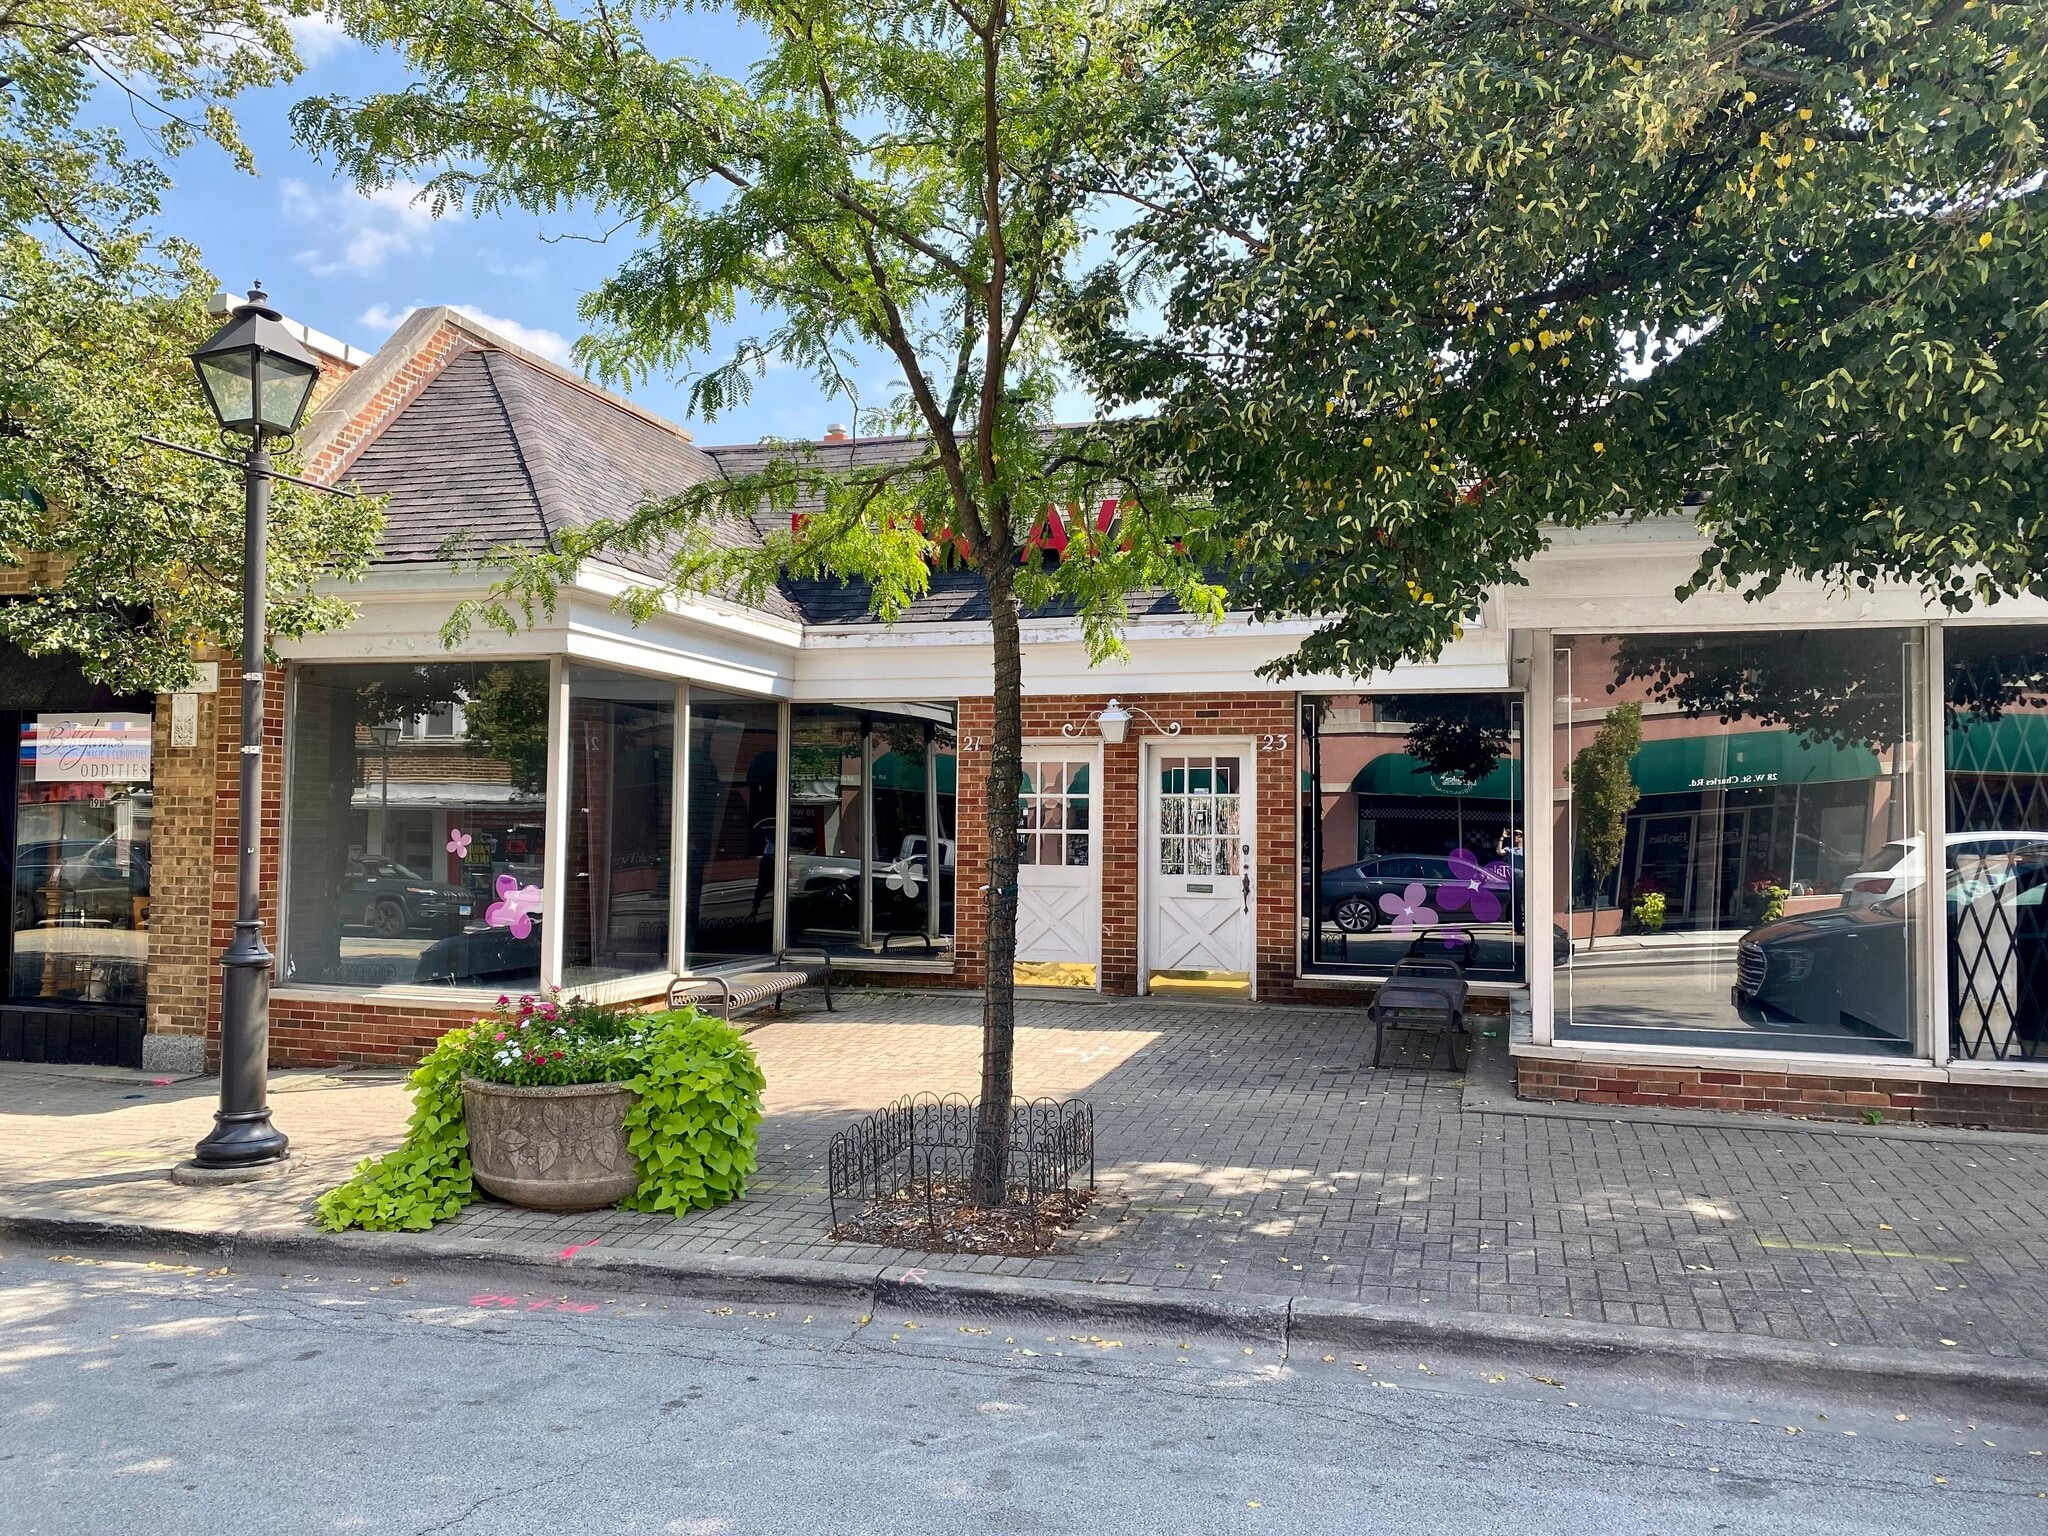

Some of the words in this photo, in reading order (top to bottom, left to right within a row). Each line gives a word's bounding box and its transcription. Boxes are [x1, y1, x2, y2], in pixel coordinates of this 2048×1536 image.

[963, 736, 981, 751] 21
[1262, 734, 1288, 751] 23
[81, 763, 147, 777] ODDITIES
